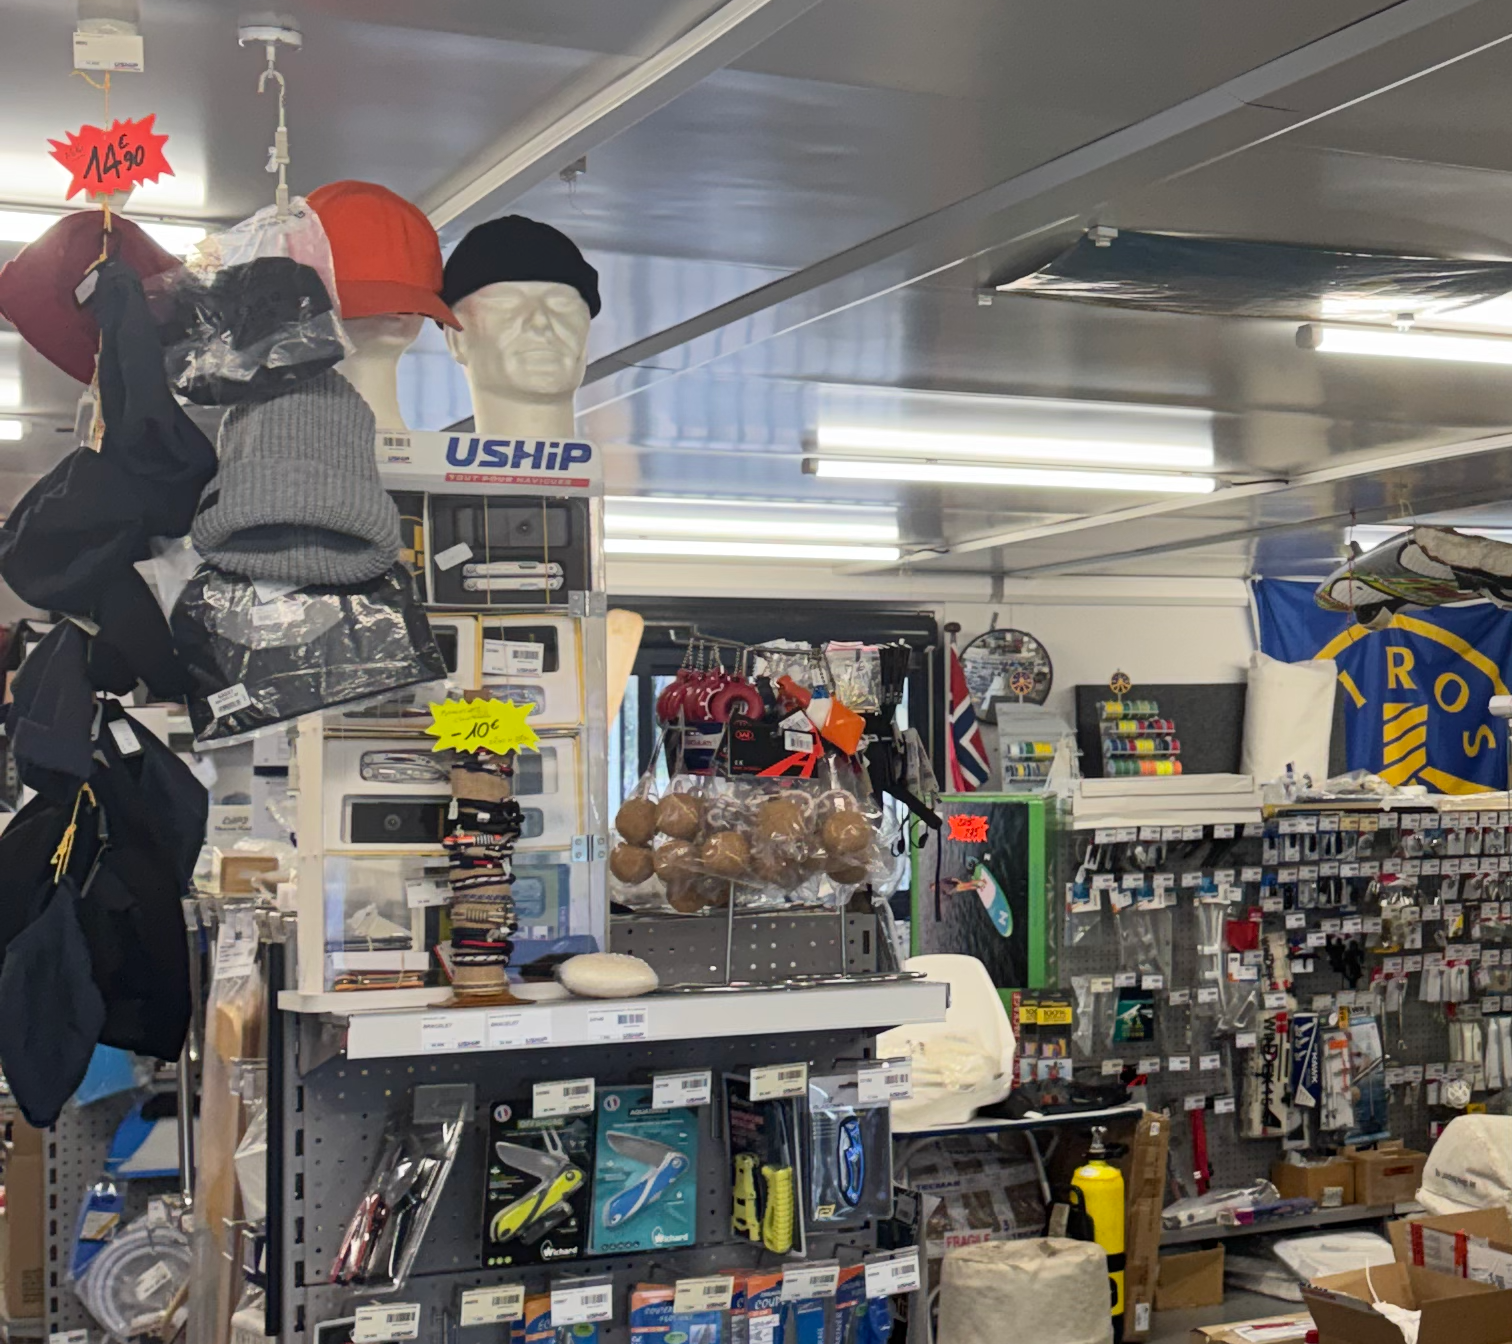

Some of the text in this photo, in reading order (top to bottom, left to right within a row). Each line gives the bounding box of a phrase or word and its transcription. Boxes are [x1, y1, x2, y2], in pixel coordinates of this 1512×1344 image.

[449, 473, 478, 483] TOUT
[517, 475, 573, 487] NAVIGUER
[653, 1230, 689, 1244] Wichard
[945, 1233, 990, 1248] FRAGILE
[542, 1243, 578, 1258] Wichard
